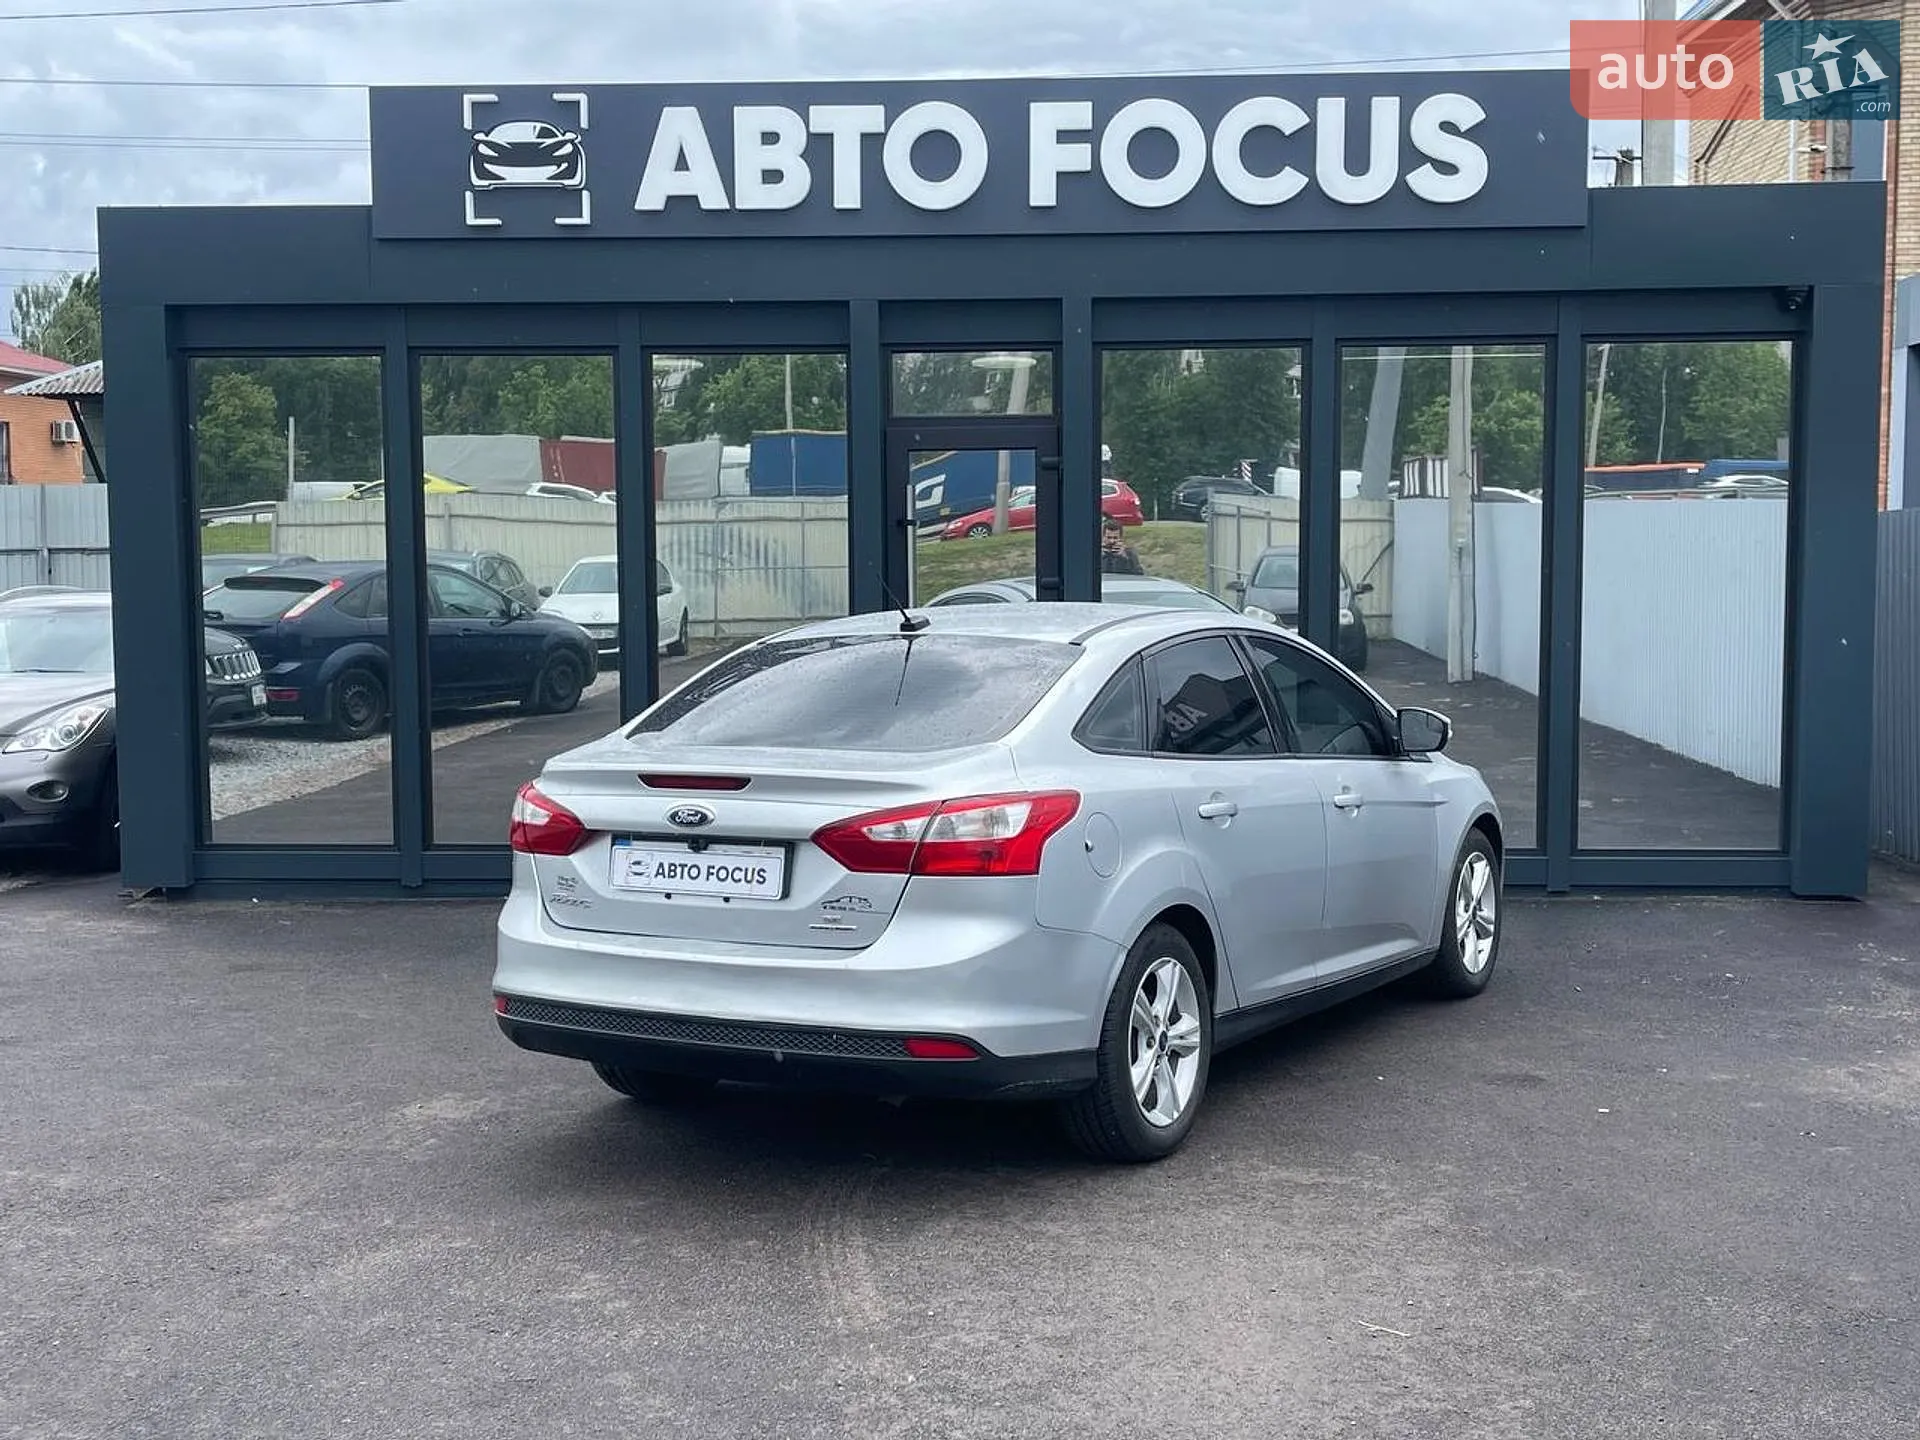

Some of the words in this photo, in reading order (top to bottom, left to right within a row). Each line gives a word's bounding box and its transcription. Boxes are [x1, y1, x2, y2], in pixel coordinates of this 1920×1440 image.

[634, 100, 989, 212] АВТО
[1029, 93, 1489, 208] FOCUS
[675, 809, 702, 823] Ford
[654, 862, 700, 881] АВТО
[706, 864, 767, 885] FOCUS
